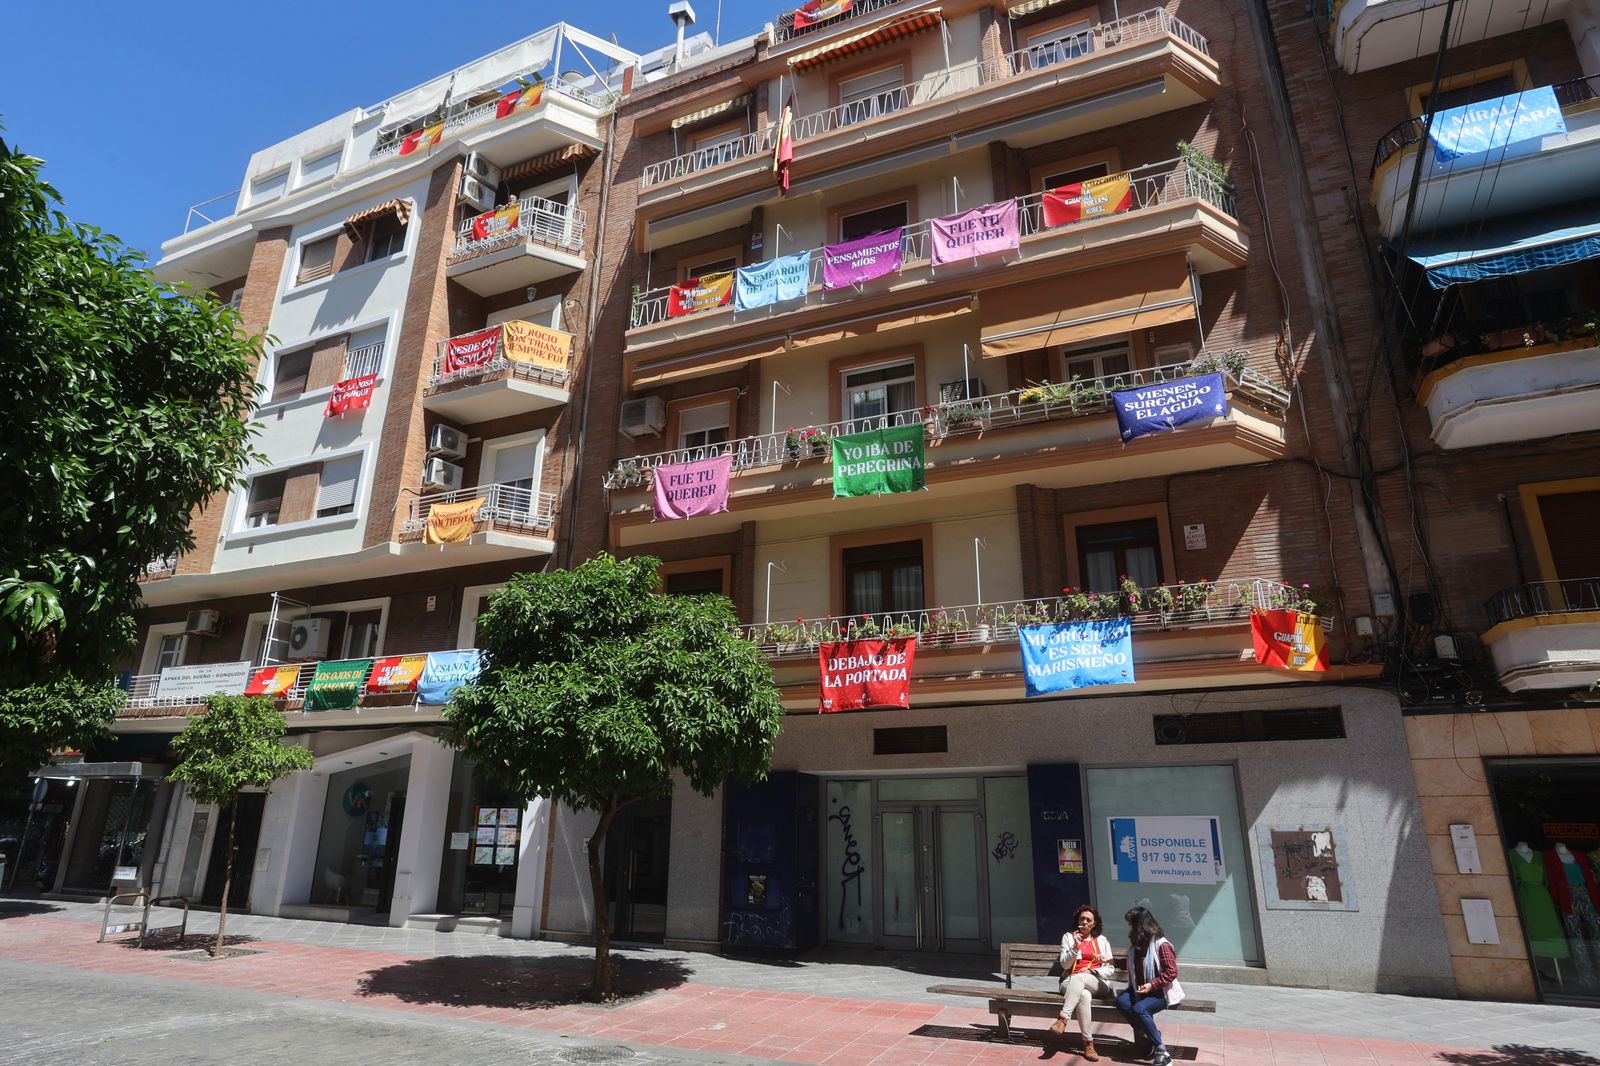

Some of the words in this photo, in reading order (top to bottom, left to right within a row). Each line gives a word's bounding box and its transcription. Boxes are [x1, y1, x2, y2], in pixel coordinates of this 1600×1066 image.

[1504, 106, 1558, 128] CARA
[950, 218, 977, 236] FUE
[979, 213, 1001, 228] TU
[946, 228, 1005, 249] QUERER
[827, 240, 900, 265] PENSAMIENTOS
[851, 256, 876, 269] MÍOS
[754, 262, 808, 284] EMBARQUE
[746, 284, 764, 295] DEL
[450, 343, 480, 356] DESDE
[504, 342, 545, 358] SIEMPRE
[547, 351, 563, 363] FUI
[528, 337, 563, 354] TRIANA
[456, 348, 492, 365] SEVILLA
[1125, 386, 1211, 412] SURCANDO
[1136, 382, 1197, 400] VIENEN
[1136, 408, 1157, 420] EL
[1160, 396, 1203, 416] AGUA
[843, 447, 862, 460] YO
[866, 442, 890, 458] IBA
[894, 440, 914, 455] DE
[838, 455, 921, 477] PEREGRINA
[670, 472, 694, 487] FUE
[697, 468, 714, 483] TU
[666, 484, 716, 503] QUERER
[1026, 633, 1045, 647] MI
[828, 654, 884, 671] DEBAJO
[886, 652, 906, 666] DE
[1048, 646, 1068, 660] ES
[1070, 644, 1103, 656] SER
[1026, 652, 1126, 677] MARISMEÑO
[330, 671, 351, 681] OJOS
[352, 669, 365, 679] DE
[824, 674, 842, 688] LA
[846, 667, 907, 686] PORTADA
[1140, 837, 1206, 848] DISPONIBLE
[1141, 852, 1159, 863] 917
[1163, 852, 1176, 863] 90
[1179, 852, 1192, 863] 75
[1195, 853, 1208, 864] 32
[1150, 867, 1202, 877] www.haya.es
